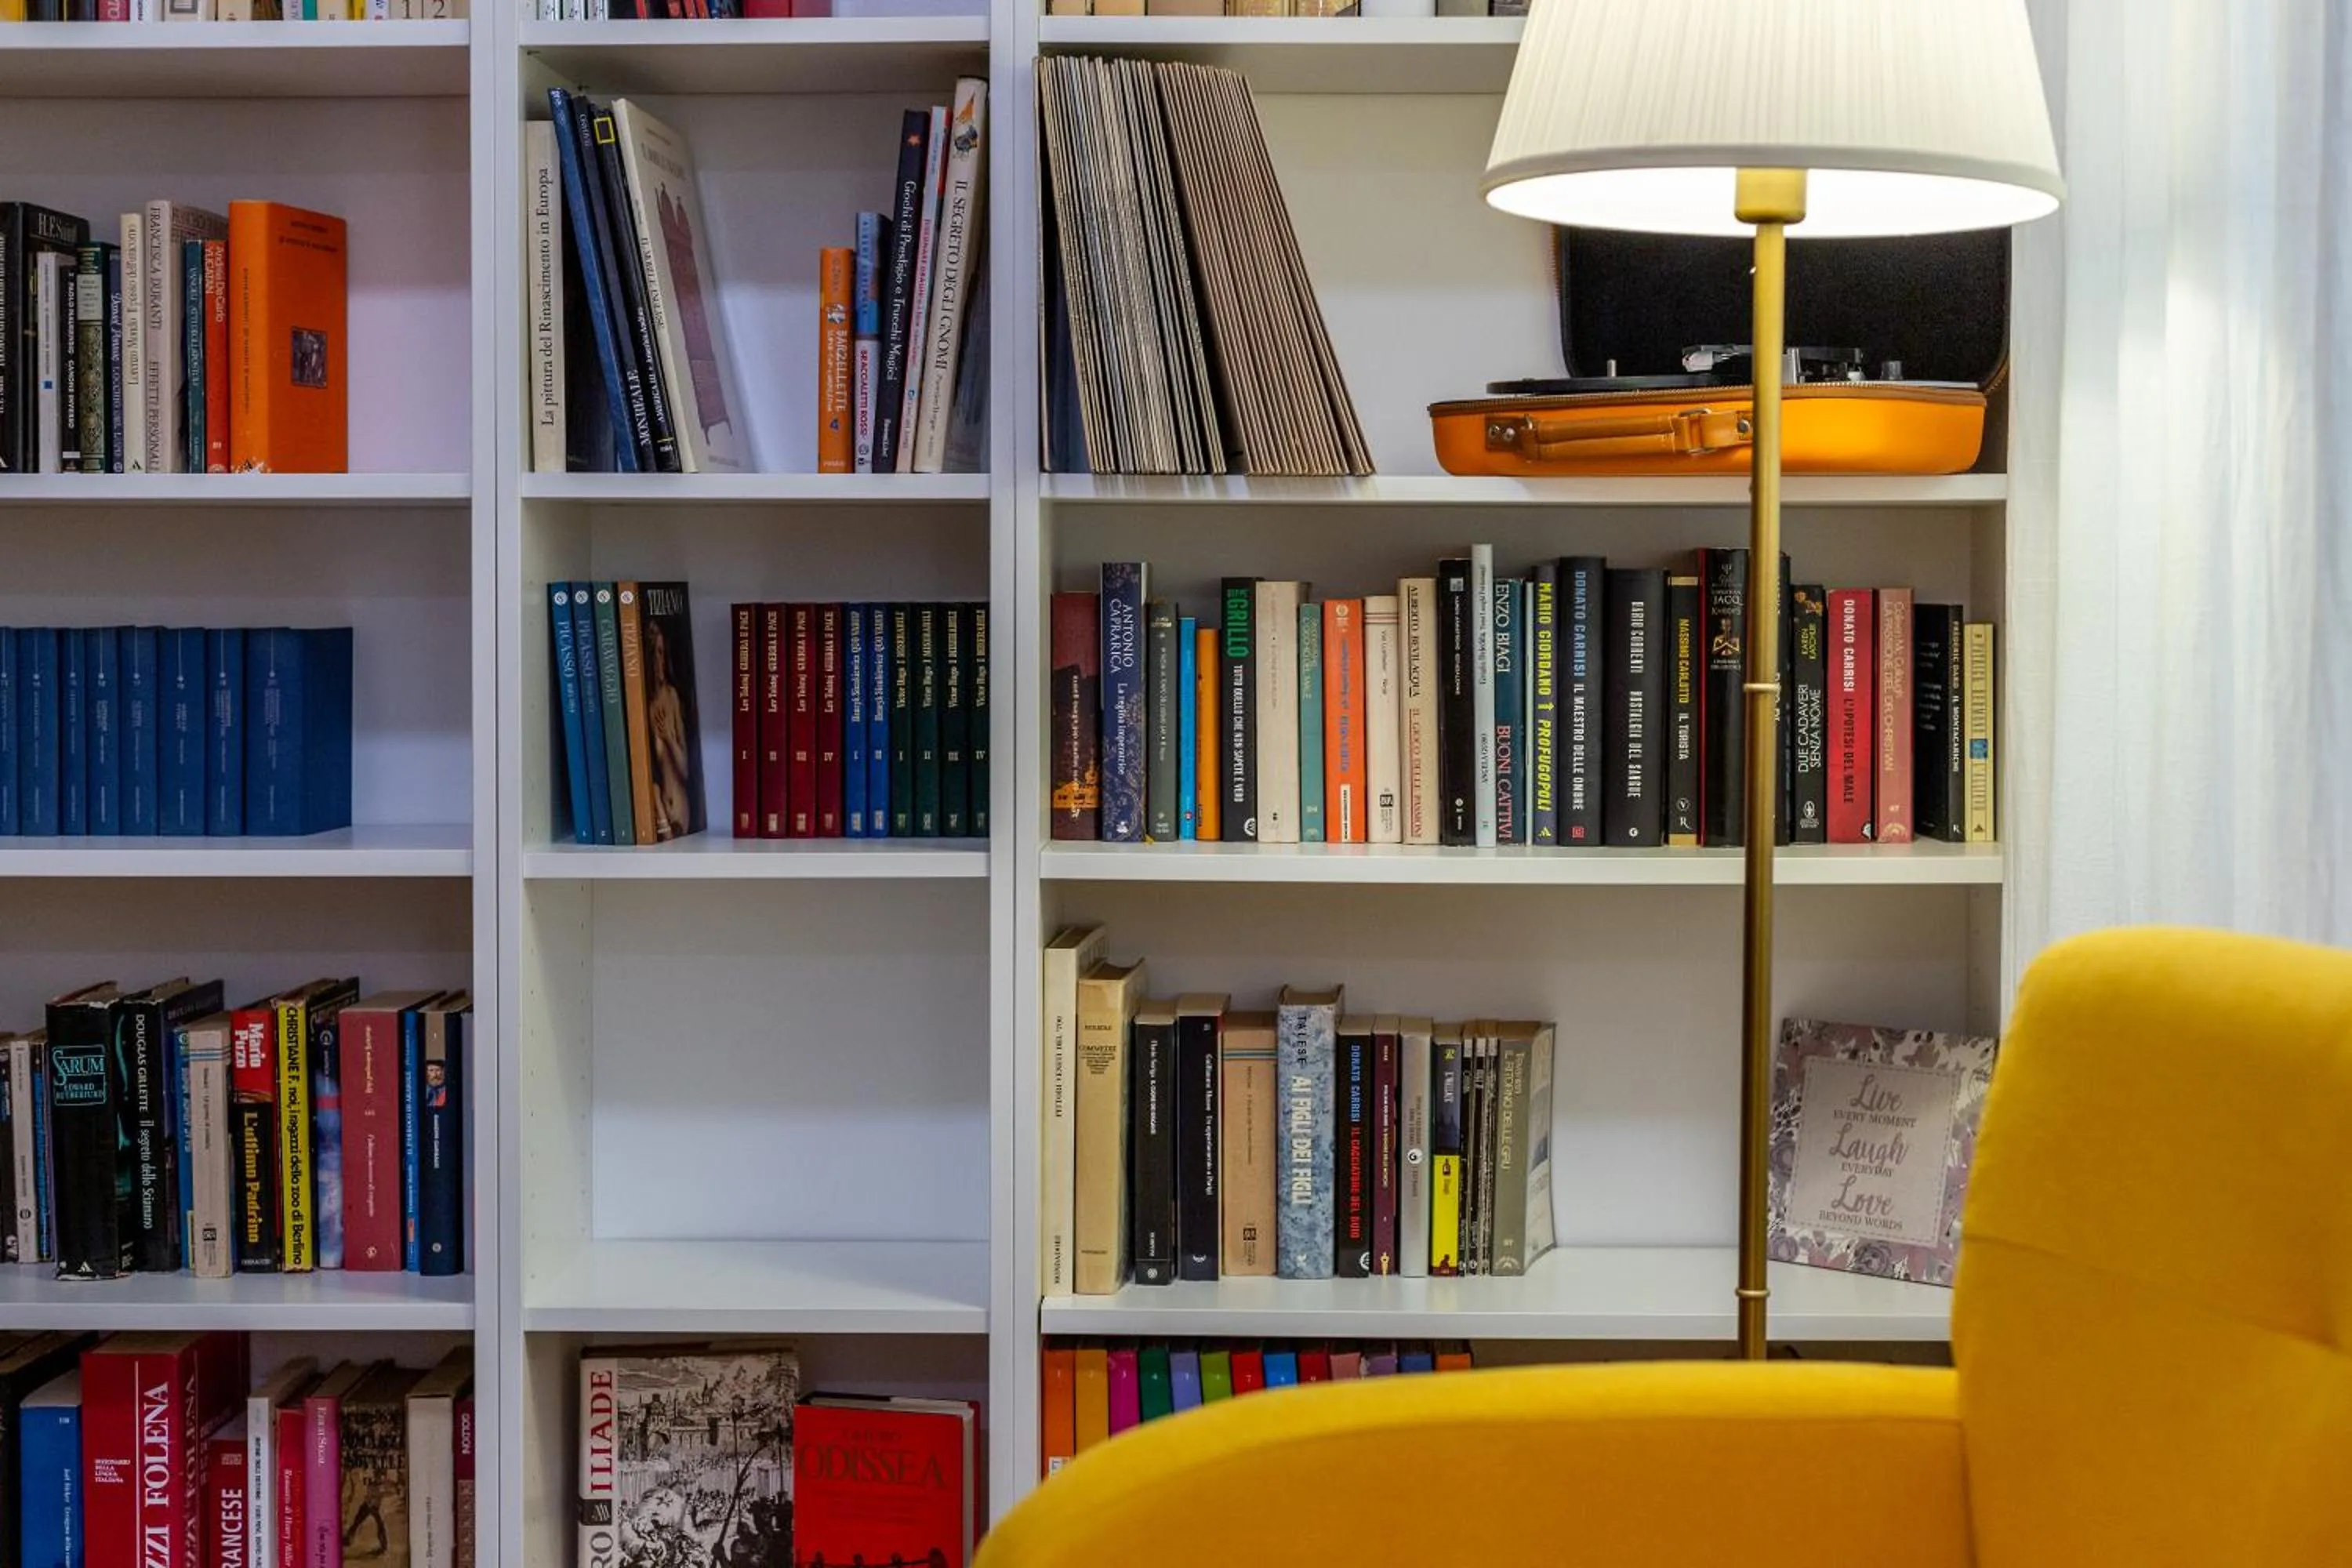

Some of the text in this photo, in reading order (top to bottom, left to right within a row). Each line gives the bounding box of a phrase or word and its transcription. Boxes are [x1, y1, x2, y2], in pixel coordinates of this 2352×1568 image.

[900, 180, 915, 218] Giochi
[955, 180, 969, 193] IL
[898, 220, 911, 232] di
[946, 197, 967, 264] SEGRETO
[151, 207, 162, 329] FRANCESCA DURANTI
[205, 245, 214, 293] YUCATAN
[216, 245, 224, 280] Andrea
[893, 234, 910, 284] Prestigio
[538, 169, 559, 426] La pittura del Rinascimento in Europa
[940, 267, 958, 312] DEGLI
[889, 296, 904, 341] Trucchi
[884, 343, 900, 381] Magici
[932, 315, 952, 369] GNOMI
[836, 329, 848, 412] BARZELLETTE
[626, 369, 652, 447] MONREALE
[858, 350, 868, 436] BRACCIALETTI ROSSI
[149, 361, 159, 470] EFFETTI PERSONALI
[648, 589, 683, 615] TIZIANO
[1713, 595, 1744, 607] JACQ
[1885, 602, 1893, 615] LA
[557, 621, 575, 677] PICASSO
[579, 619, 593, 676] PICASSO
[623, 622, 638, 677] TIZIANO
[1110, 599, 1122, 673] CAPRARICA
[1123, 604, 1134, 667] ANTONIO
[1227, 598, 1250, 658] GRILLO
[1496, 584, 1510, 672] ENZO BIAGI
[1679, 619, 1689, 659] MASSIMO
[1885, 617, 1893, 668] PASSIONE
[601, 619, 617, 703] CARAVAGGIO
[1234, 665, 1243, 685] TUTTO
[1411, 636, 1420, 697] BEVILACQUA
[1679, 660, 1689, 703] CARLOTTO
[1885, 671, 1893, 692] DEL
[1233, 688, 1243, 713] QUELLO
[1539, 583, 1552, 811] MARIO GIORDANO PROFUGOPOLI
[1573, 572, 1586, 810] DONATO CARRISI IL MAESTRO DELLE OMBRE
[1628, 601, 1643, 797] DARIO CORRENTI NOSTALGIA DEL SANGUE
[1844, 600, 1854, 804] DONATO CARRISI L'IPOTESI DEL MALE
[1116, 683, 1126, 775] La regina imperatrice
[1234, 716, 1243, 730] CHE
[1412, 709, 1420, 719] IL
[1798, 685, 1809, 772] DUE CADAVERI
[1810, 690, 1820, 768] SENZA NOME
[1234, 732, 1243, 748] NON
[1679, 724, 1689, 760] TURISTA
[1885, 716, 1893, 771] CHRISTIAN
[1234, 750, 1243, 776] SAPETE
[1497, 726, 1512, 839] BUONI CATTIVI
[136, 1014, 147, 1065] DOUGLAS
[235, 1030, 248, 1067] Puzo
[249, 1023, 264, 1067] Mario
[287, 1007, 299, 1071] CHRISTIANE
[1298, 1016, 1307, 1065] TALESE
[53, 1050, 104, 1086] SARUM
[138, 1068, 148, 1112] GILLETTE
[285, 1088, 299, 1108] noi,
[1351, 1085, 1359, 1122] CARRISI
[1501, 1050, 1512, 1169] IL RITORNO DELLE GRU
[1851, 1074, 1902, 1111] Live
[287, 1115, 299, 1153] ragazzi
[1292, 1076, 1312, 1204] AI FIGLI DEI FIGLI
[1352, 1127, 1359, 1136] IL
[1834, 1109, 1917, 1127] EVERY MOMENT
[139, 1129, 151, 1160] segreto
[1351, 1139, 1359, 1192] CACCIATORE
[1830, 1123, 1907, 1166] Laugh
[142, 1163, 156, 1186] dello
[244, 1112, 262, 1243] L'ultimo Padrino
[289, 1156, 300, 1185] dello
[1842, 1163, 1893, 1178] EVERYDAY
[143, 1188, 154, 1229] Sciamano
[293, 1210, 303, 1221] di
[1351, 1195, 1359, 1213] DEL
[1831, 1175, 1893, 1215] Love
[1350, 1216, 1359, 1238] BUIO
[1819, 1210, 1902, 1230] BEYOND WORDS
[293, 1225, 304, 1265] Berlino
[143, 1382, 169, 1508] FOLENA
[590, 1370, 613, 1493] ILIADE
[800, 1444, 946, 1488] ODISSEA
